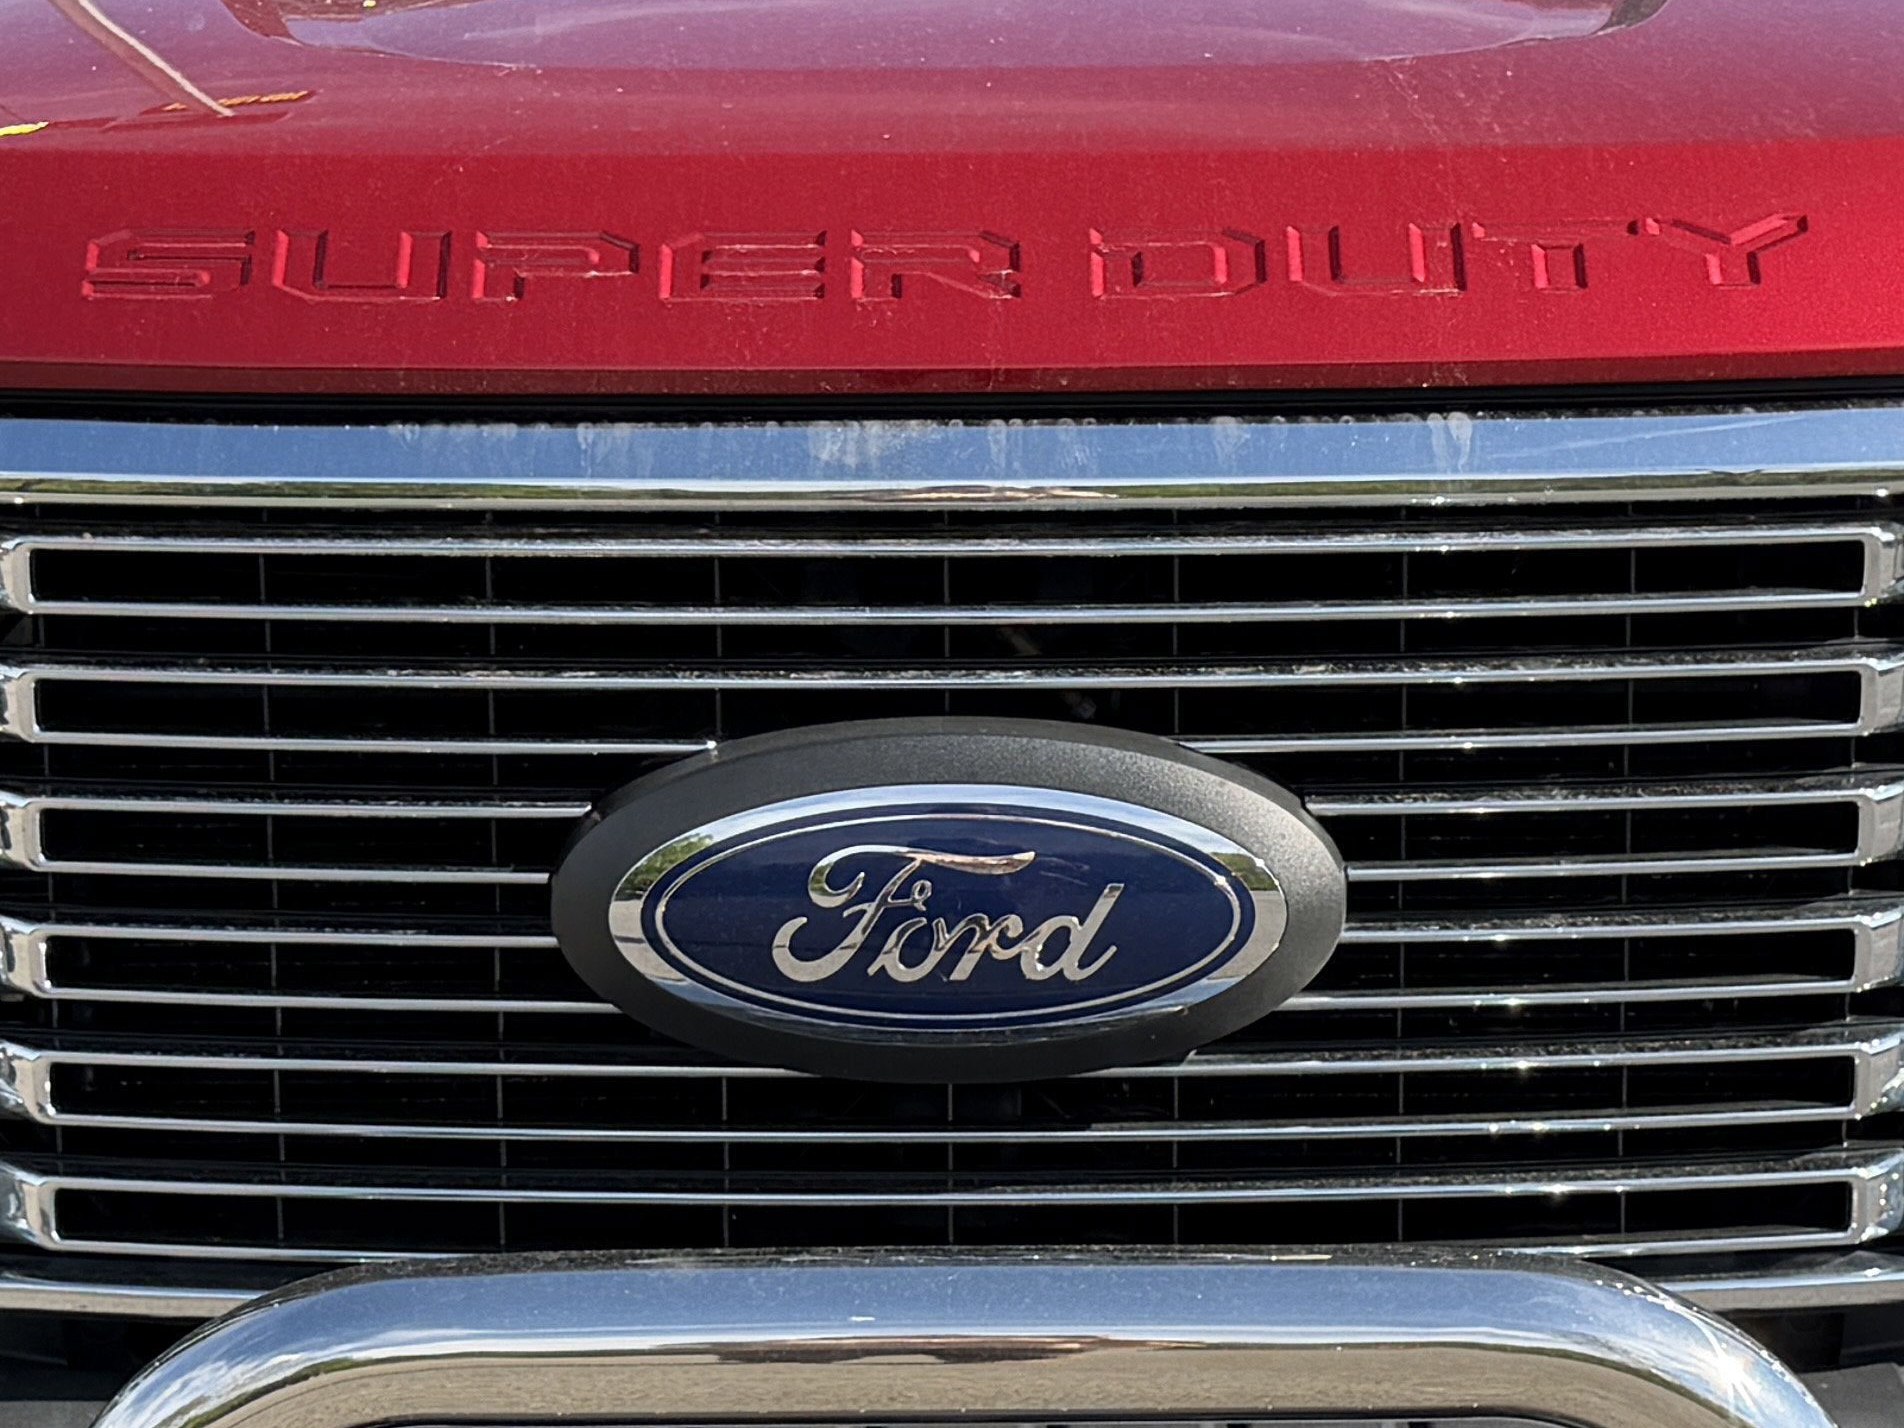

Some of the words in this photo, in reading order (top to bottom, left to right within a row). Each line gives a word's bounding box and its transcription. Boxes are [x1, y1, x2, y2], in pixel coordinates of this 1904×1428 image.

[83, 228, 1022, 305] SUPER
[1088, 214, 1810, 300] DUTY
[771, 843, 1126, 983] Ford
